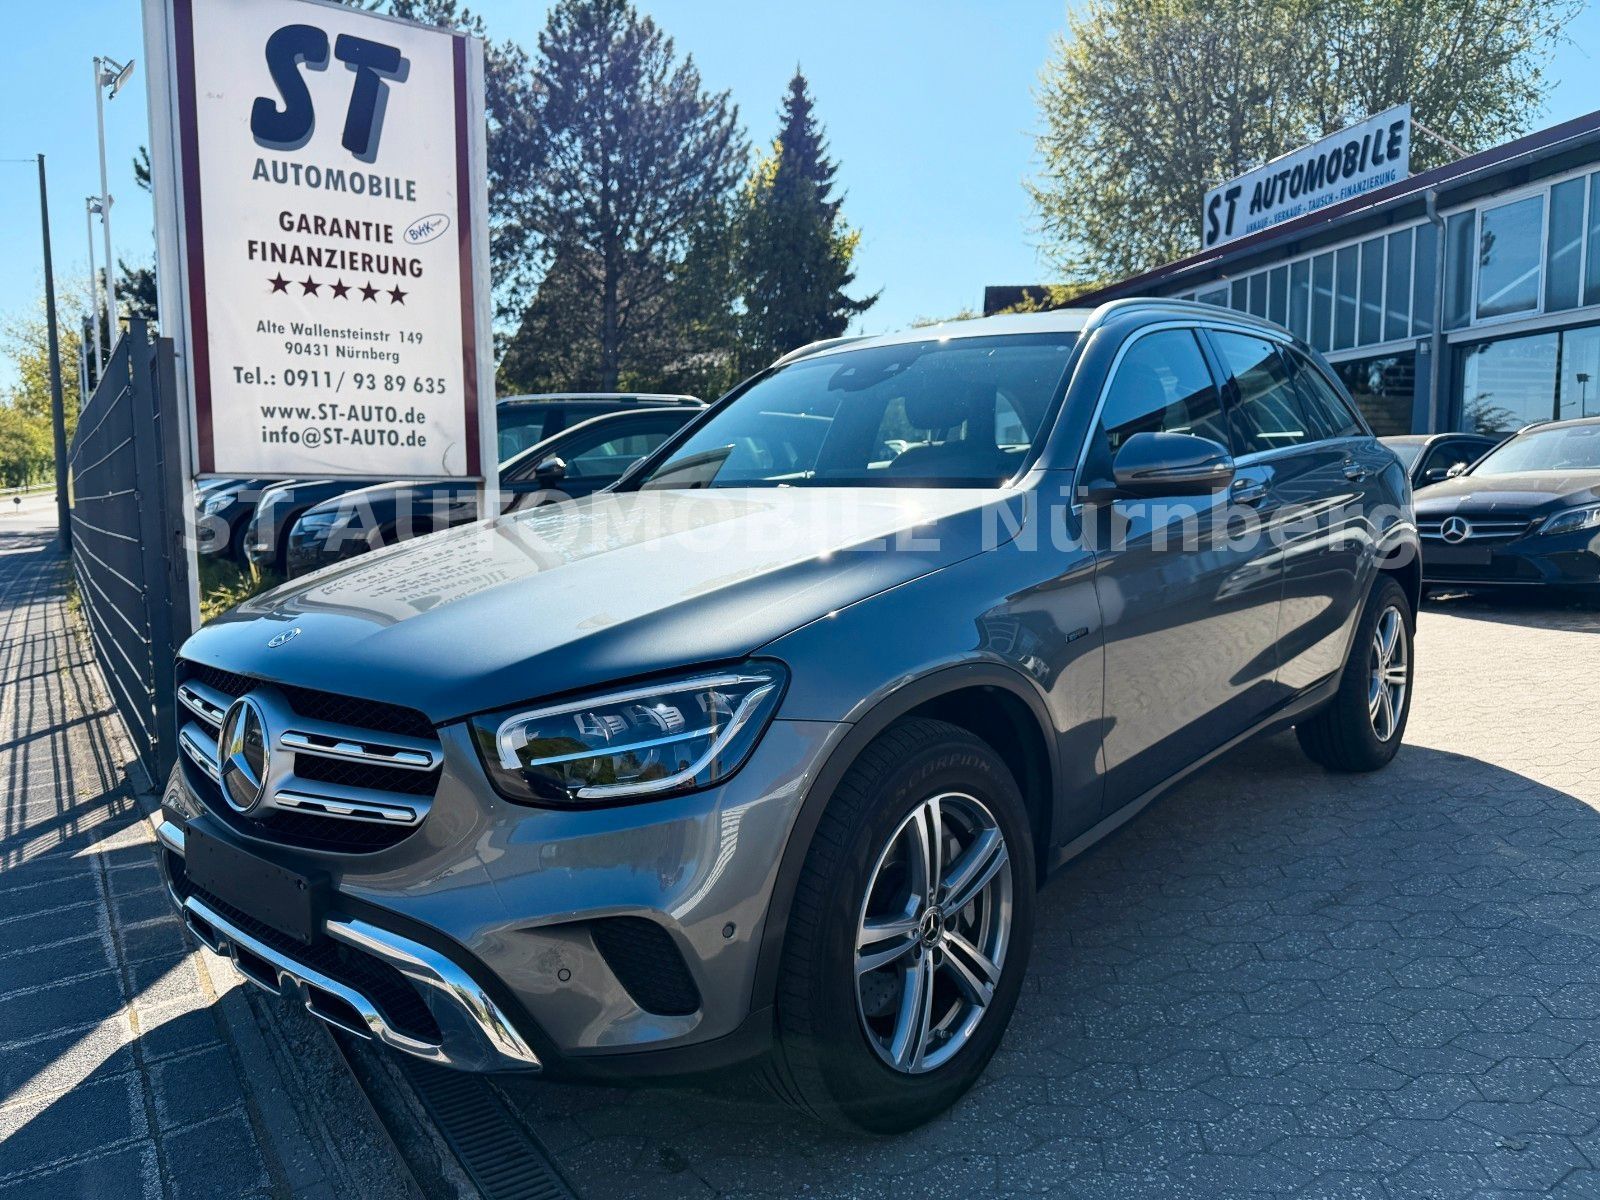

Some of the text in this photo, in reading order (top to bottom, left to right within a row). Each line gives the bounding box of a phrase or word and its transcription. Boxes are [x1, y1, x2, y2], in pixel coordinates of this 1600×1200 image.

[250, 23, 411, 164] ST
[252, 157, 417, 202] AUTOMOBILE
[1206, 119, 1406, 246] ST AUTOMOBILE
[1308, 193, 1333, 211] TAUSCH
[1341, 169, 1396, 198] FINANZIERUNG
[278, 210, 394, 244] GARANTIE
[247, 240, 424, 278] FINANZIERUNG
[256, 319, 424, 345] Alte Wallensteinstr 149
[284, 341, 401, 365] 90431 Nürnberg
[233, 365, 277, 386] Tel.:
[353, 373, 377, 391] 93
[383, 375, 406, 393] 89
[413, 377, 447, 395] 635
[260, 403, 427, 424] www.ST-AUTO.de
[261, 425, 428, 449] info@ST-AUTO.de
